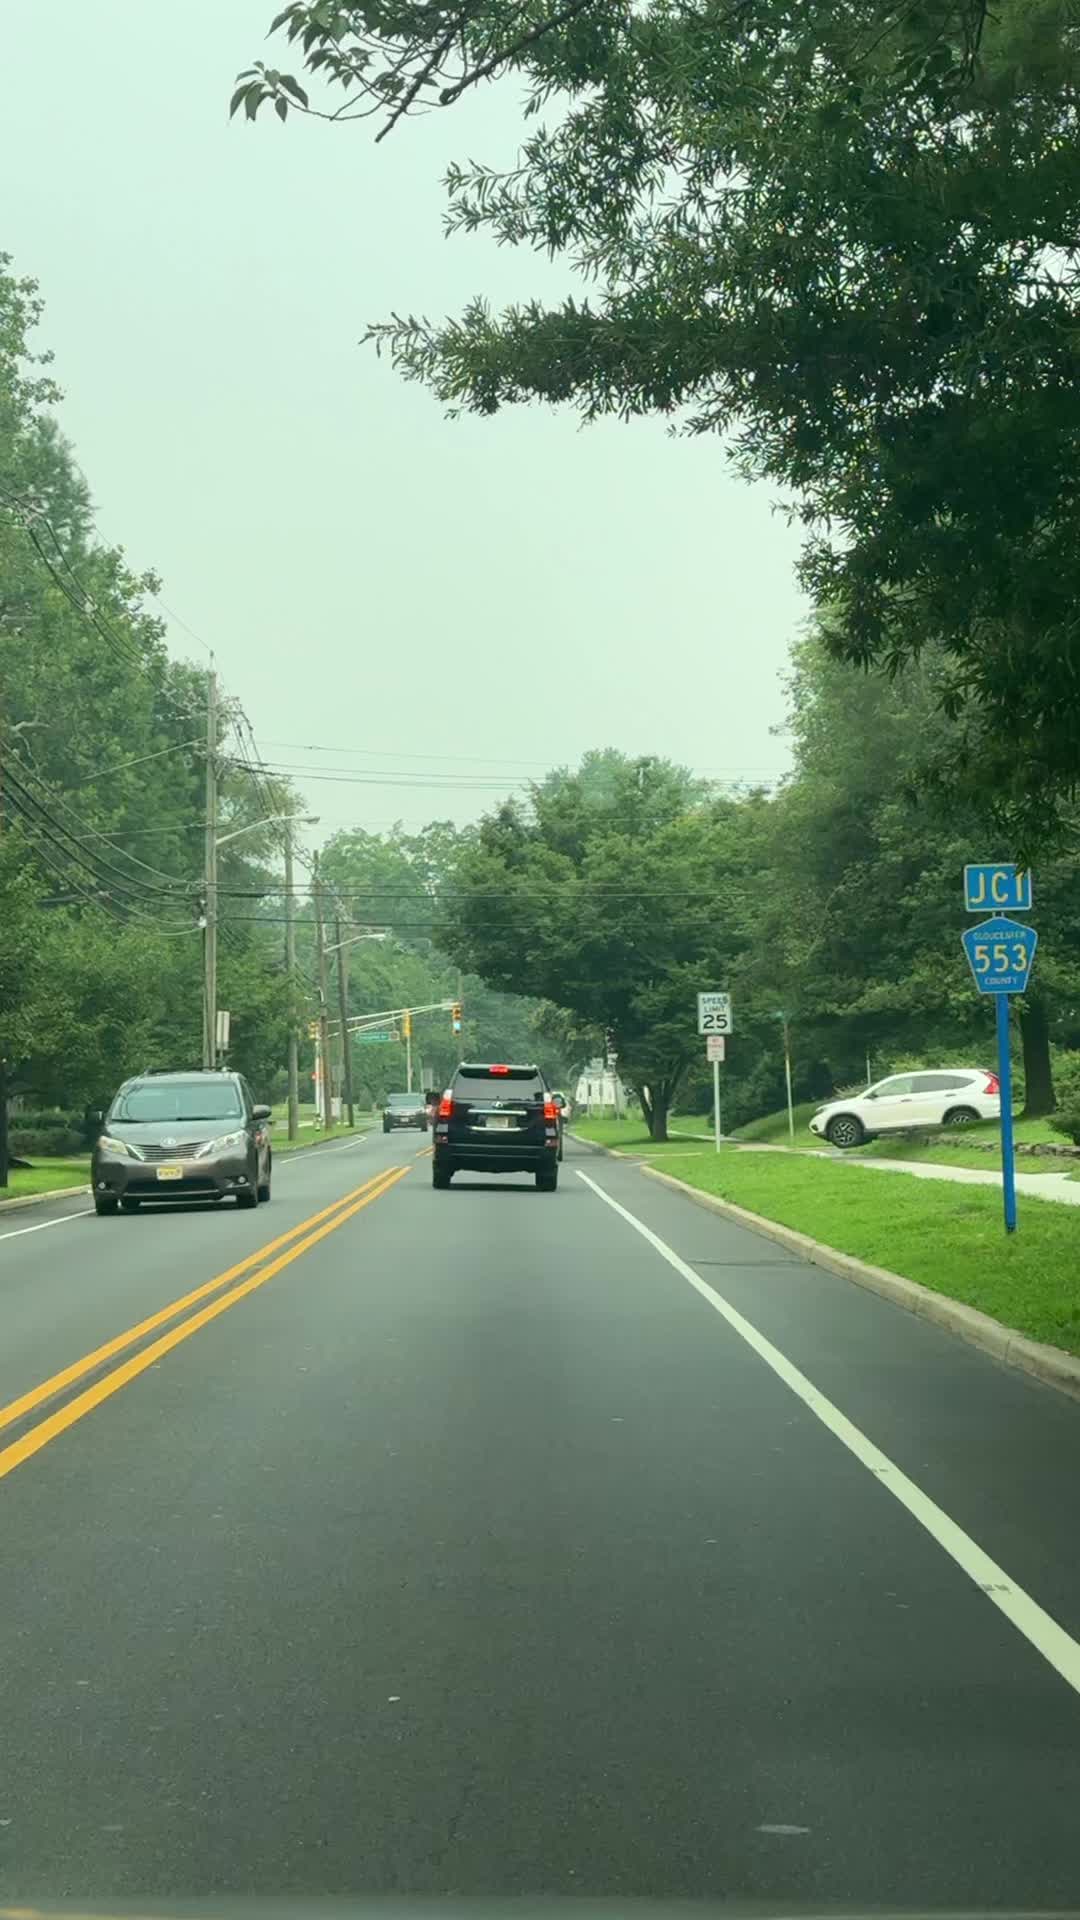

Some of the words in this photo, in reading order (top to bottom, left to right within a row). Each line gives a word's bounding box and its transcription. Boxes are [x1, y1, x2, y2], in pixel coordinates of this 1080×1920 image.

[974, 944, 1027, 972] 553
[984, 976, 1017, 985] COUNTY
[703, 1014, 728, 1029] 25
